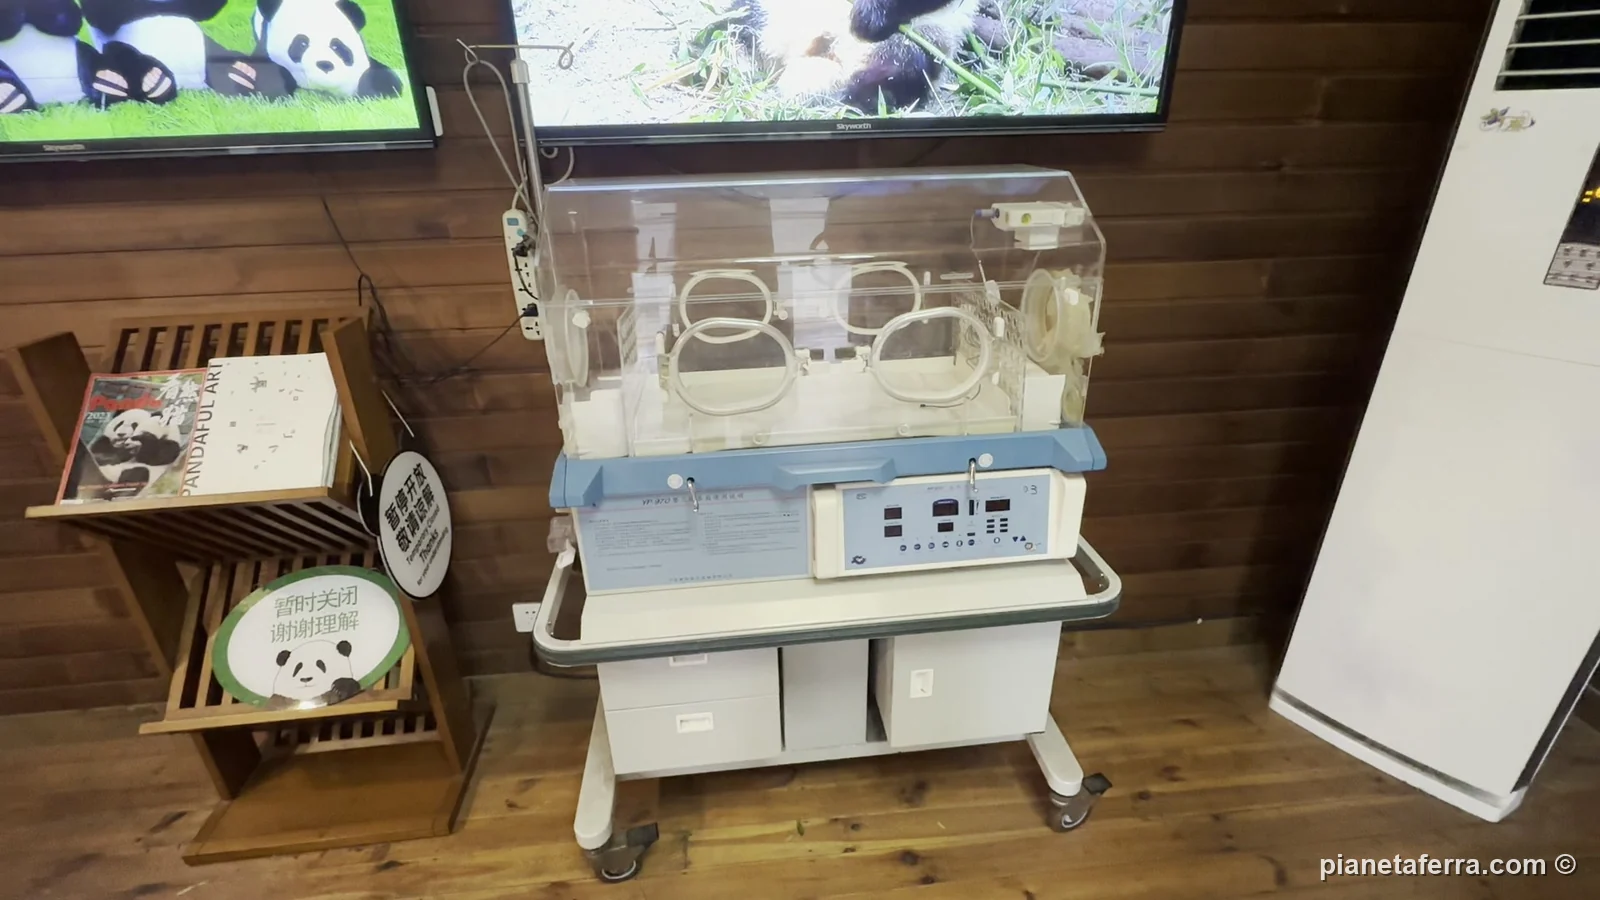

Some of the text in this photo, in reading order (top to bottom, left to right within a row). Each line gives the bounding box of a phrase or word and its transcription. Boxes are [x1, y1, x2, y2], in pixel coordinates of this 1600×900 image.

[836, 122, 872, 131] Skyworth
[204, 363, 224, 394] ART
[384, 463, 427, 532] 暂停开放
[395, 483, 435, 553] 敬请谅解
[419, 528, 439, 563] Thanks
[274, 585, 358, 619] 暂时关闭
[270, 610, 360, 644] 谢谢理解
